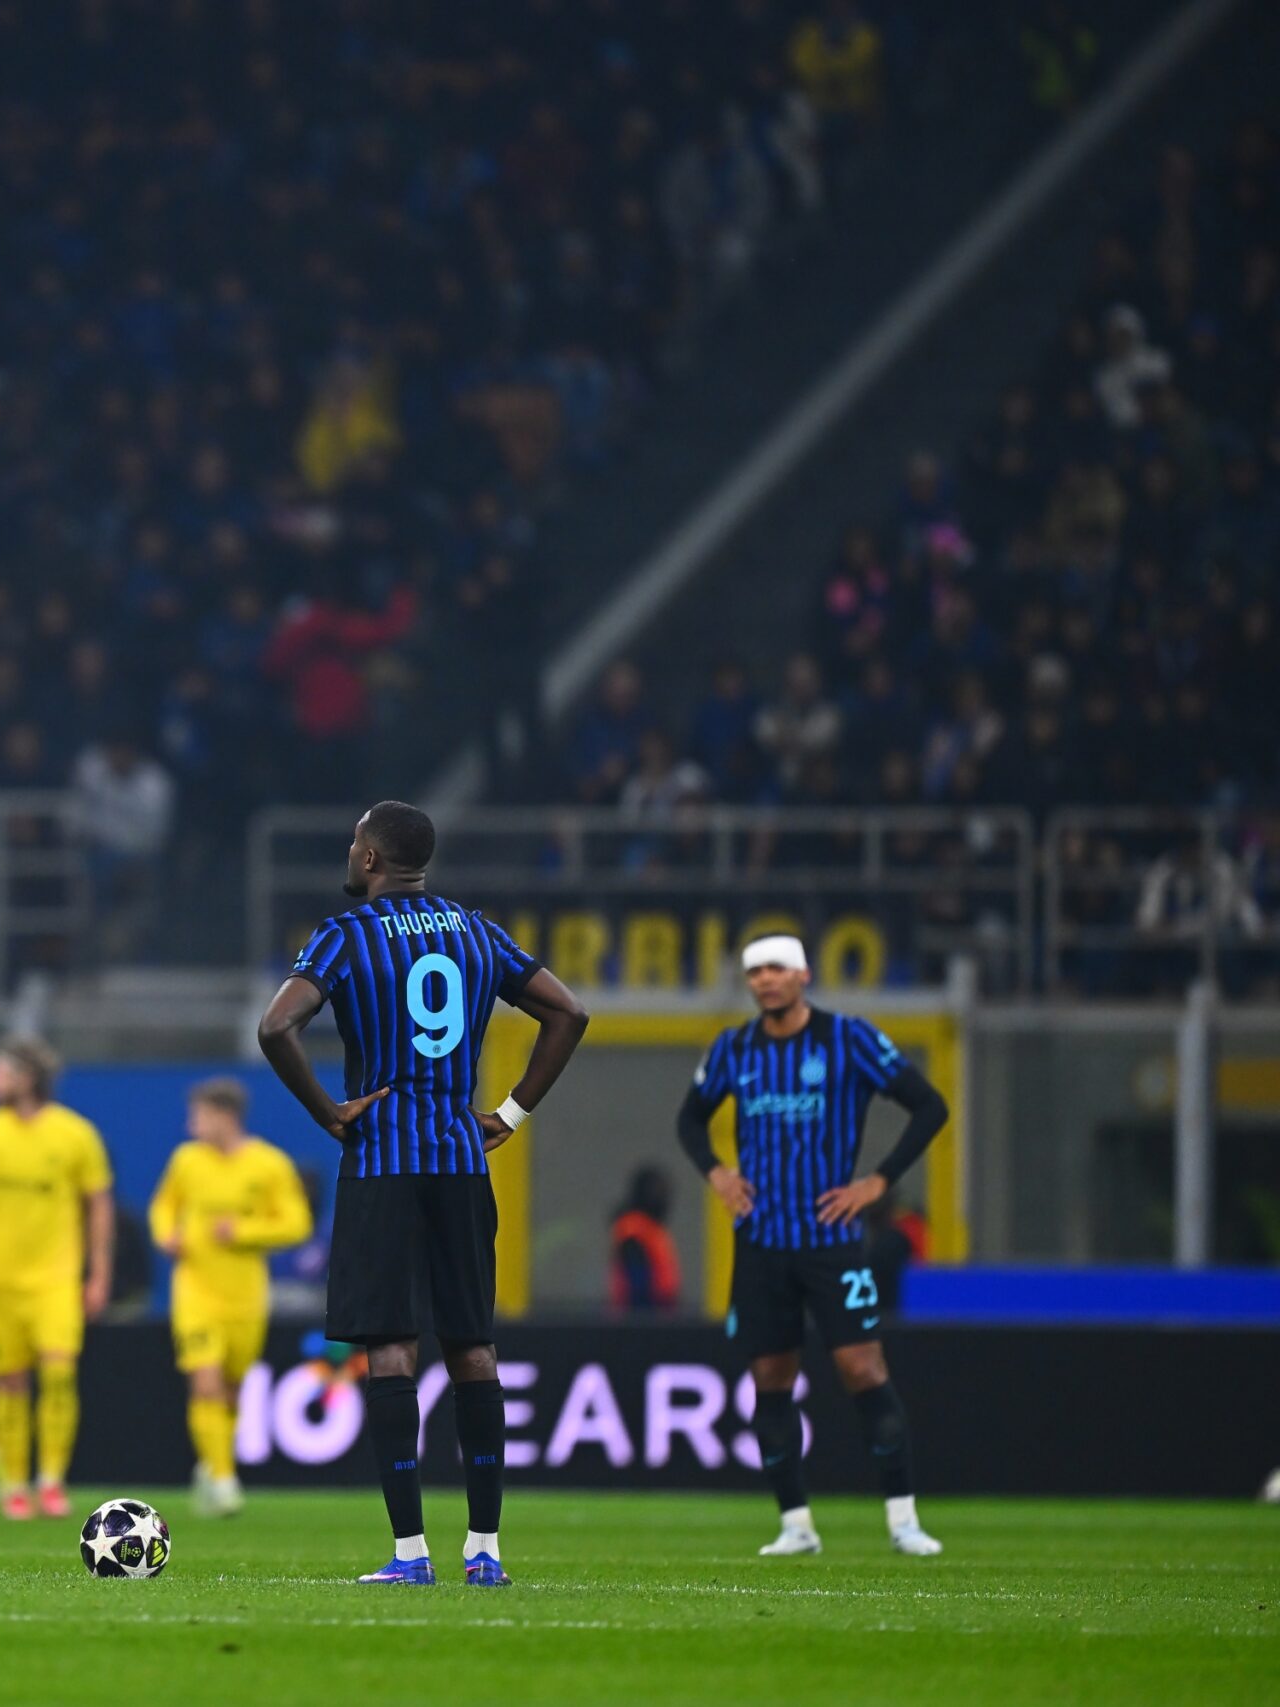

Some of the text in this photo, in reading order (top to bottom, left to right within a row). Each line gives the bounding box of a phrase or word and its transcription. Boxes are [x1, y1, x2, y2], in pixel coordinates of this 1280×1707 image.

[380, 911, 467, 938] THURAM
[406, 952, 465, 1059] 9
[393, 1459, 417, 1472] INTER
